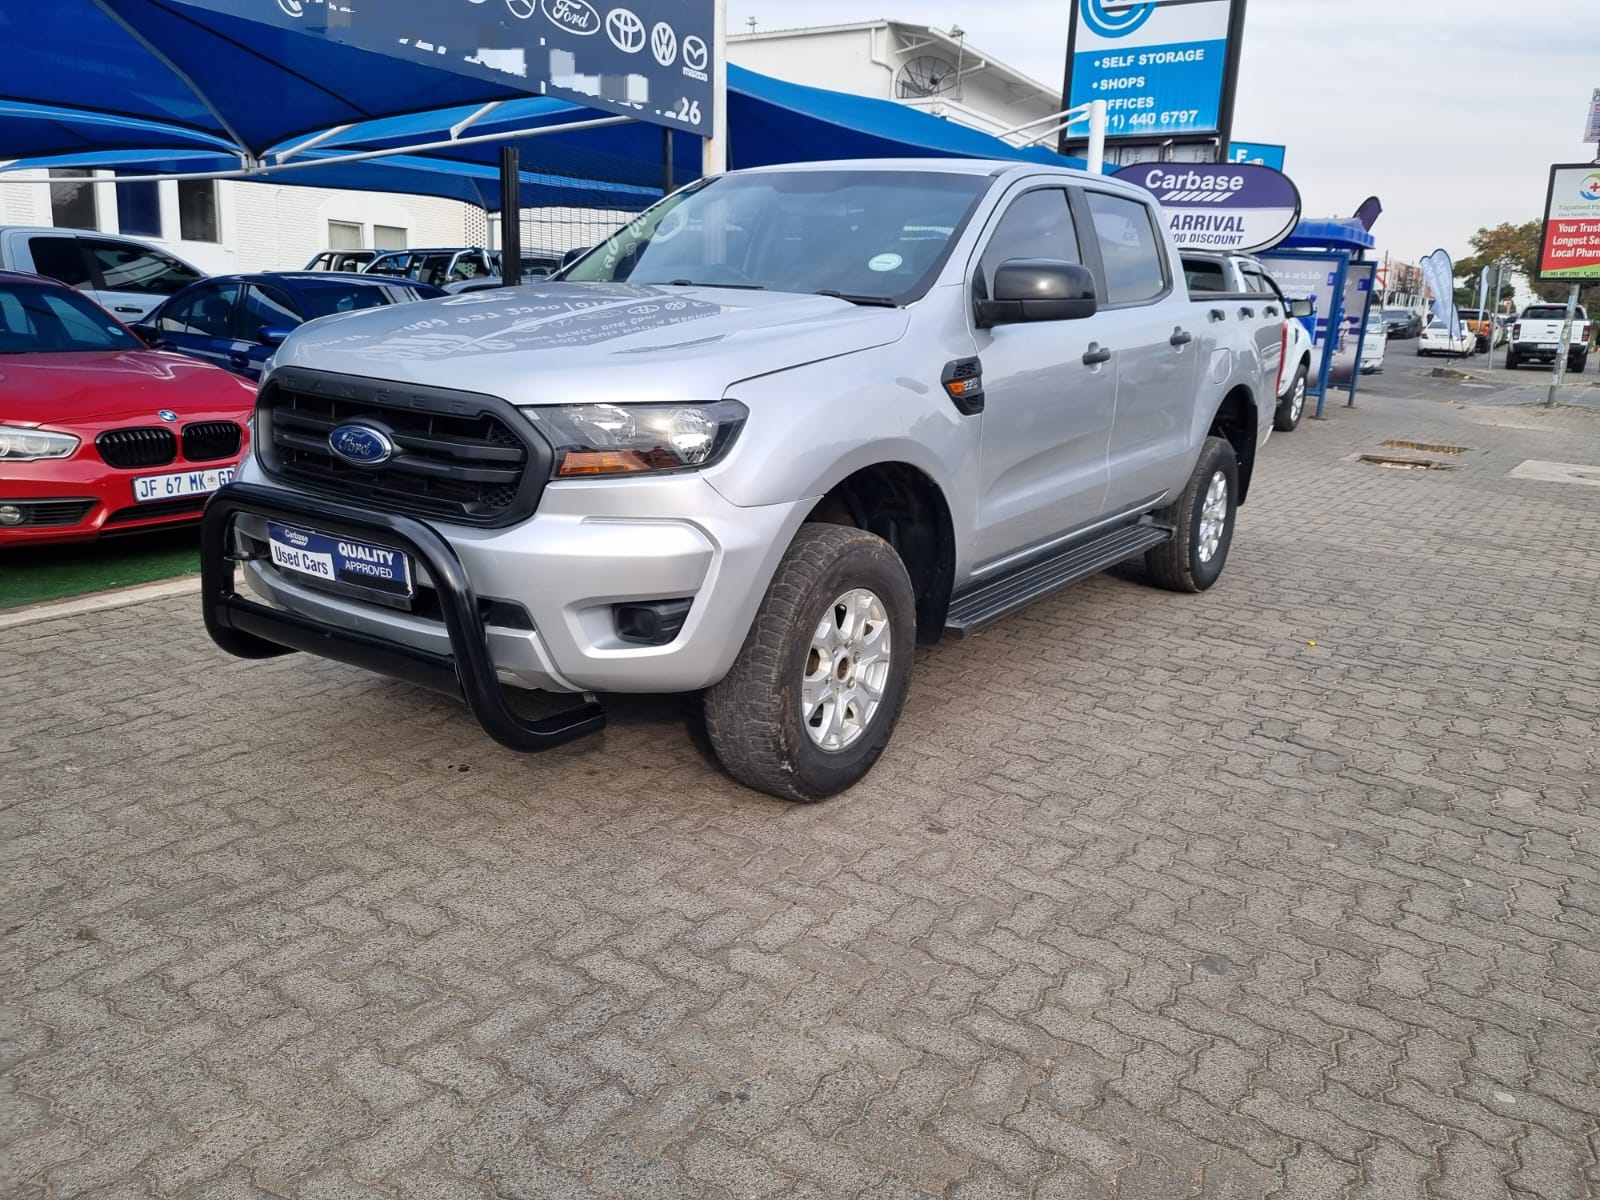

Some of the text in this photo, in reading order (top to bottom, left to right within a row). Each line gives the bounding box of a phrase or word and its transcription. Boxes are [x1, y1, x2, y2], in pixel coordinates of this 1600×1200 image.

[553, 0, 590, 28] Ford
[1102, 49, 1205, 68] SELF STORAGE
[1100, 76, 1145, 90] SHOPS
[1106, 97, 1155, 110] FFICES
[1129, 112, 1156, 126] 440
[1160, 110, 1198, 124] 6797
[1145, 169, 1244, 190] Carbase
[1169, 214, 1245, 232] ARRIVAL
[1558, 223, 1578, 233] Your
[1189, 234, 1245, 245] DISCOUNT
[1552, 235, 1587, 247] Longest
[1551, 248, 1575, 258] Local
[338, 431, 372, 456] Ford
[141, 479, 157, 498] JF
[166, 477, 182, 494] 67
[189, 473, 207, 492] MK
[284, 529, 309, 543] Carbase
[274, 545, 329, 575] Used Cars
[338, 542, 394, 565] QUALITY
[345, 560, 393, 579] APPROVED
